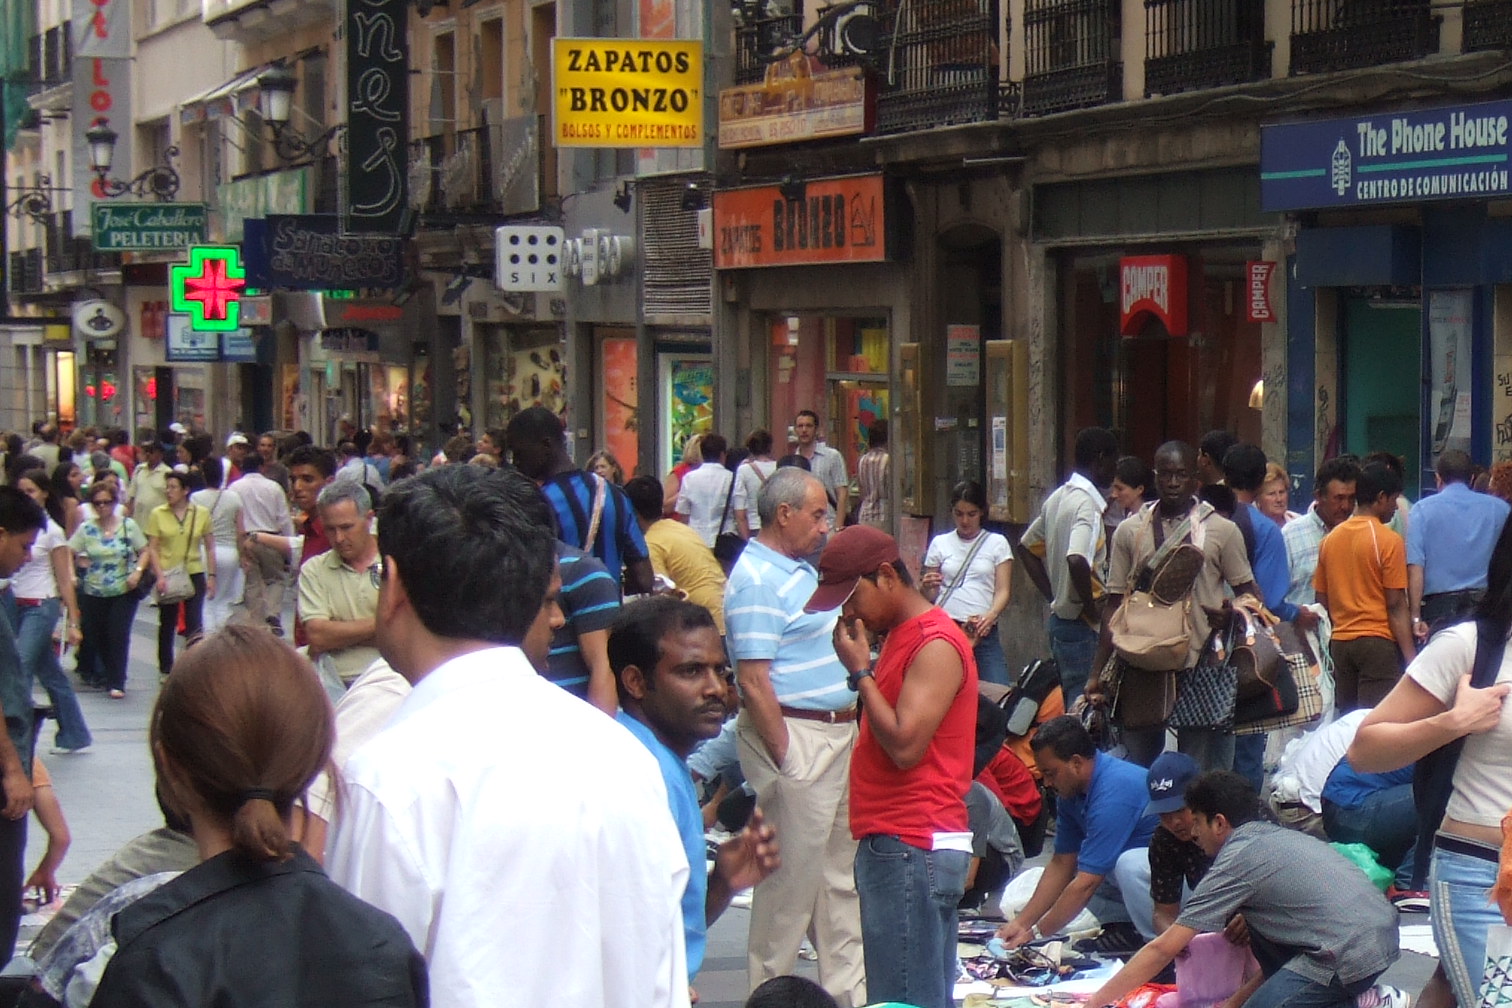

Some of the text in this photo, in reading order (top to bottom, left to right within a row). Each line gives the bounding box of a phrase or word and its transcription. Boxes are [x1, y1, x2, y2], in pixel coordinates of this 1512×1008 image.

[568, 49, 690, 74] ZAPATOS
[562, 123, 697, 139] BOLSOS Y COMPLEMENTOS
[1357, 112, 1508, 157] The Phone House
[1357, 165, 1508, 200] CENTRO DE COMUNICACIÓN
[774, 194, 846, 252] BRONZO
[511, 272, 557, 284] SIX
[1123, 266, 1168, 314] CAMPER
[1251, 264, 1269, 319] CAMPER
